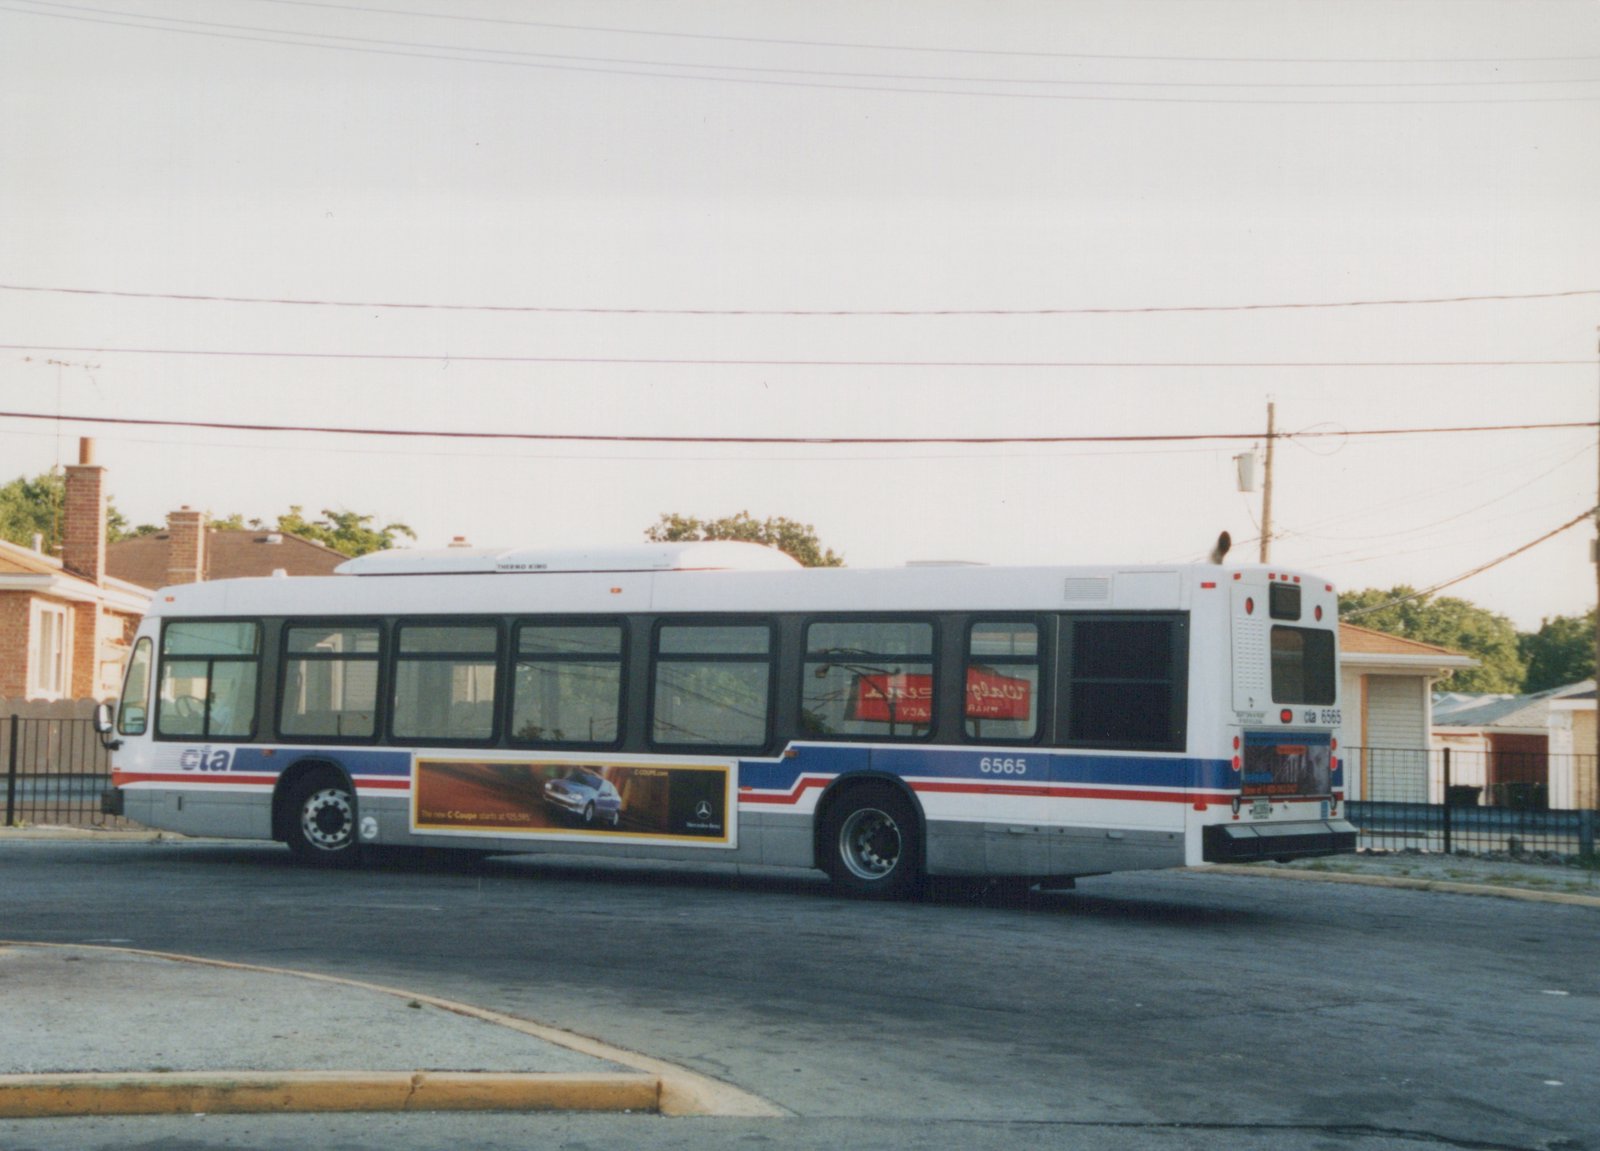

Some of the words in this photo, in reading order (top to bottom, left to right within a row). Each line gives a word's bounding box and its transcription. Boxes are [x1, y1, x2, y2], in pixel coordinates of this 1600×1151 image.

[1304, 709, 1317, 724] cta
[1321, 709, 1342, 724] 6565
[180, 745, 231, 772] cta
[980, 757, 1026, 775] 6565
